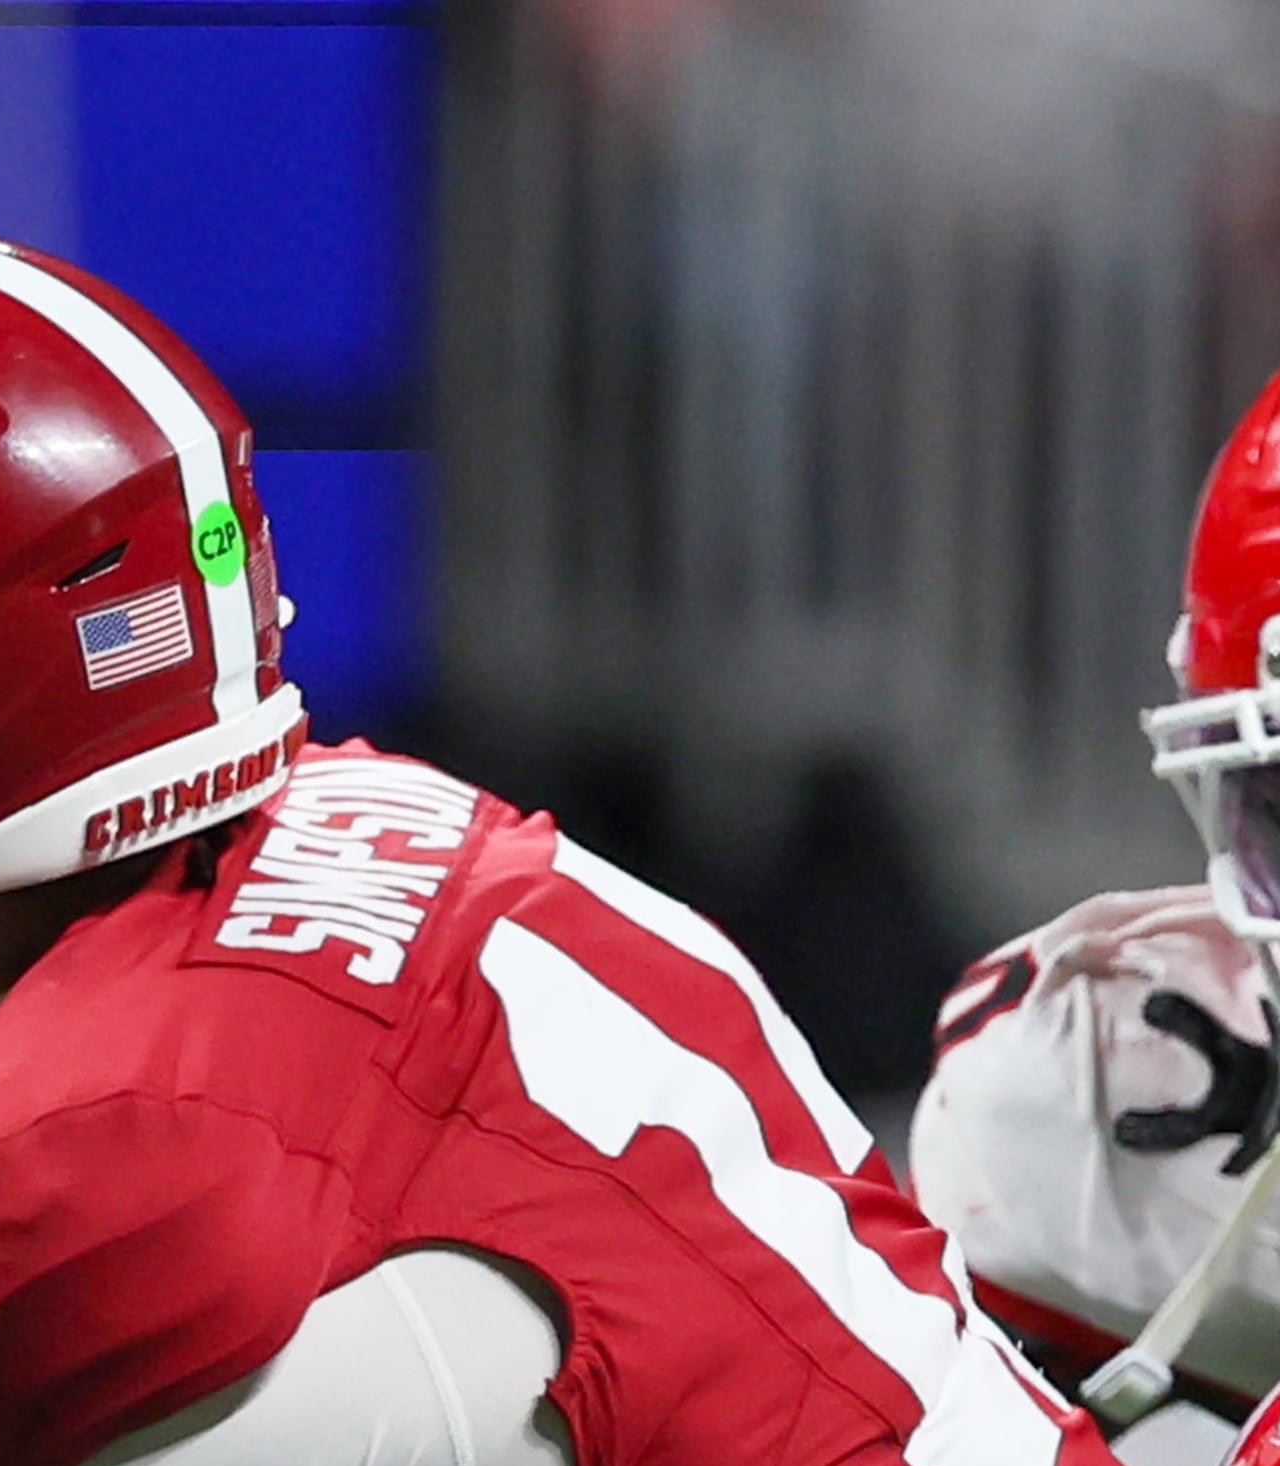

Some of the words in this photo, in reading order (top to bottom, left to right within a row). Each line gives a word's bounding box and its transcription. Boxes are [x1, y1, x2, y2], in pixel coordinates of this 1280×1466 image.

[199, 520, 237, 561] C2P
[86, 740, 279, 854] CRIMSON
[214, 757, 479, 985] SIMPSON
